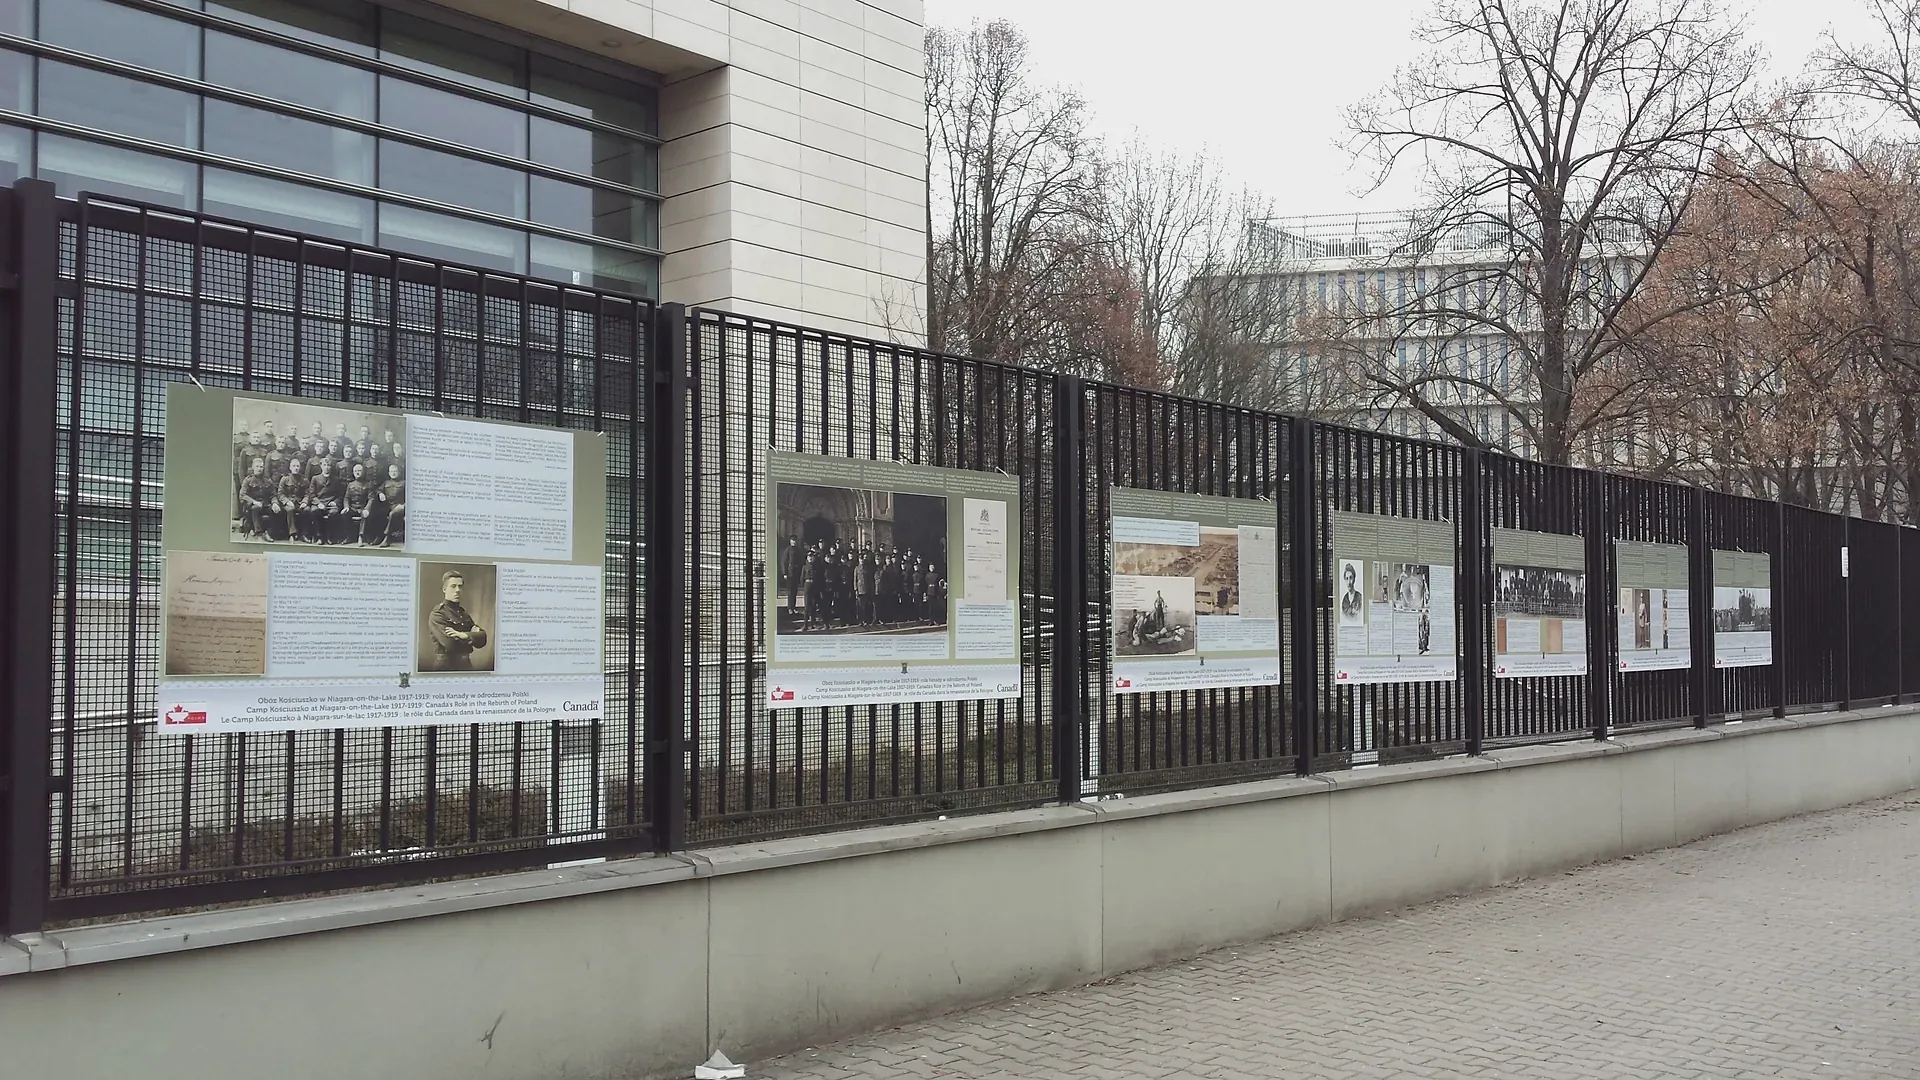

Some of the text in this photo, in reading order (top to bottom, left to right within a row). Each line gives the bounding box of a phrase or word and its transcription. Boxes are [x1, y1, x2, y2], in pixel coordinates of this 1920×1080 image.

[996, 683, 1018, 692] Canada
[327, 694, 397, 703] Niagara-on-the-Lake
[446, 692, 469, 700] Kanady
[319, 704, 389, 712] Niagara-on-the-Lake
[563, 700, 598, 712] Canada
